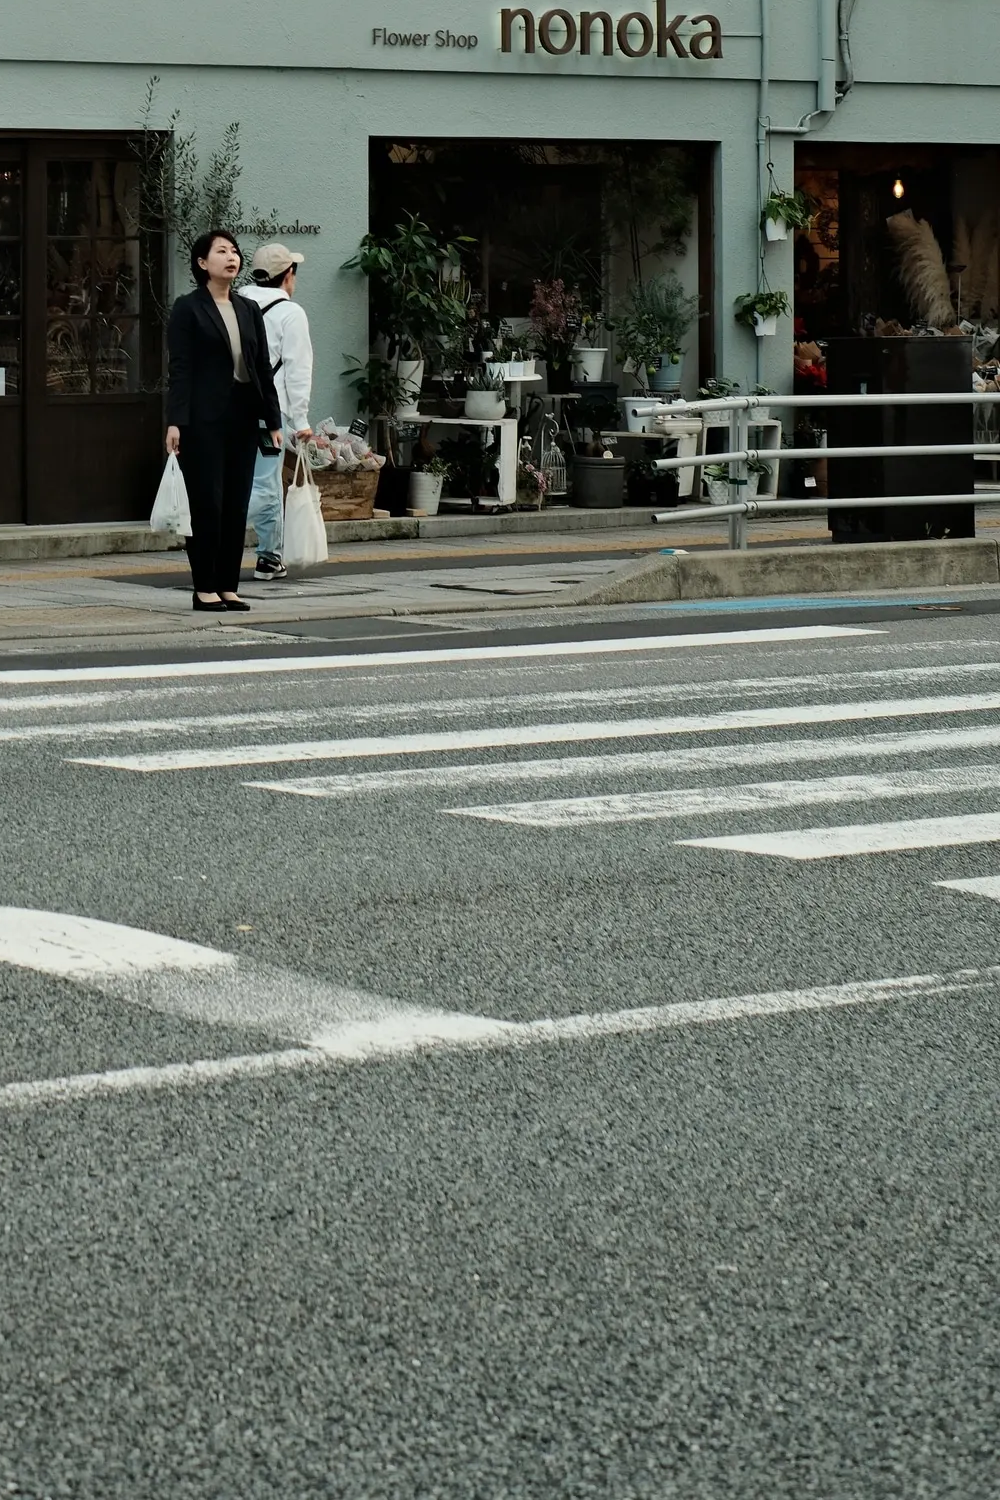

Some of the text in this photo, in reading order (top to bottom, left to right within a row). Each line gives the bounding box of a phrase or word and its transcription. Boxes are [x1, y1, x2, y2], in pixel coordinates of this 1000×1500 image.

[372, 27, 430, 47] Flower
[435, 29, 479, 49] Shop
[280, 219, 321, 235] colore
